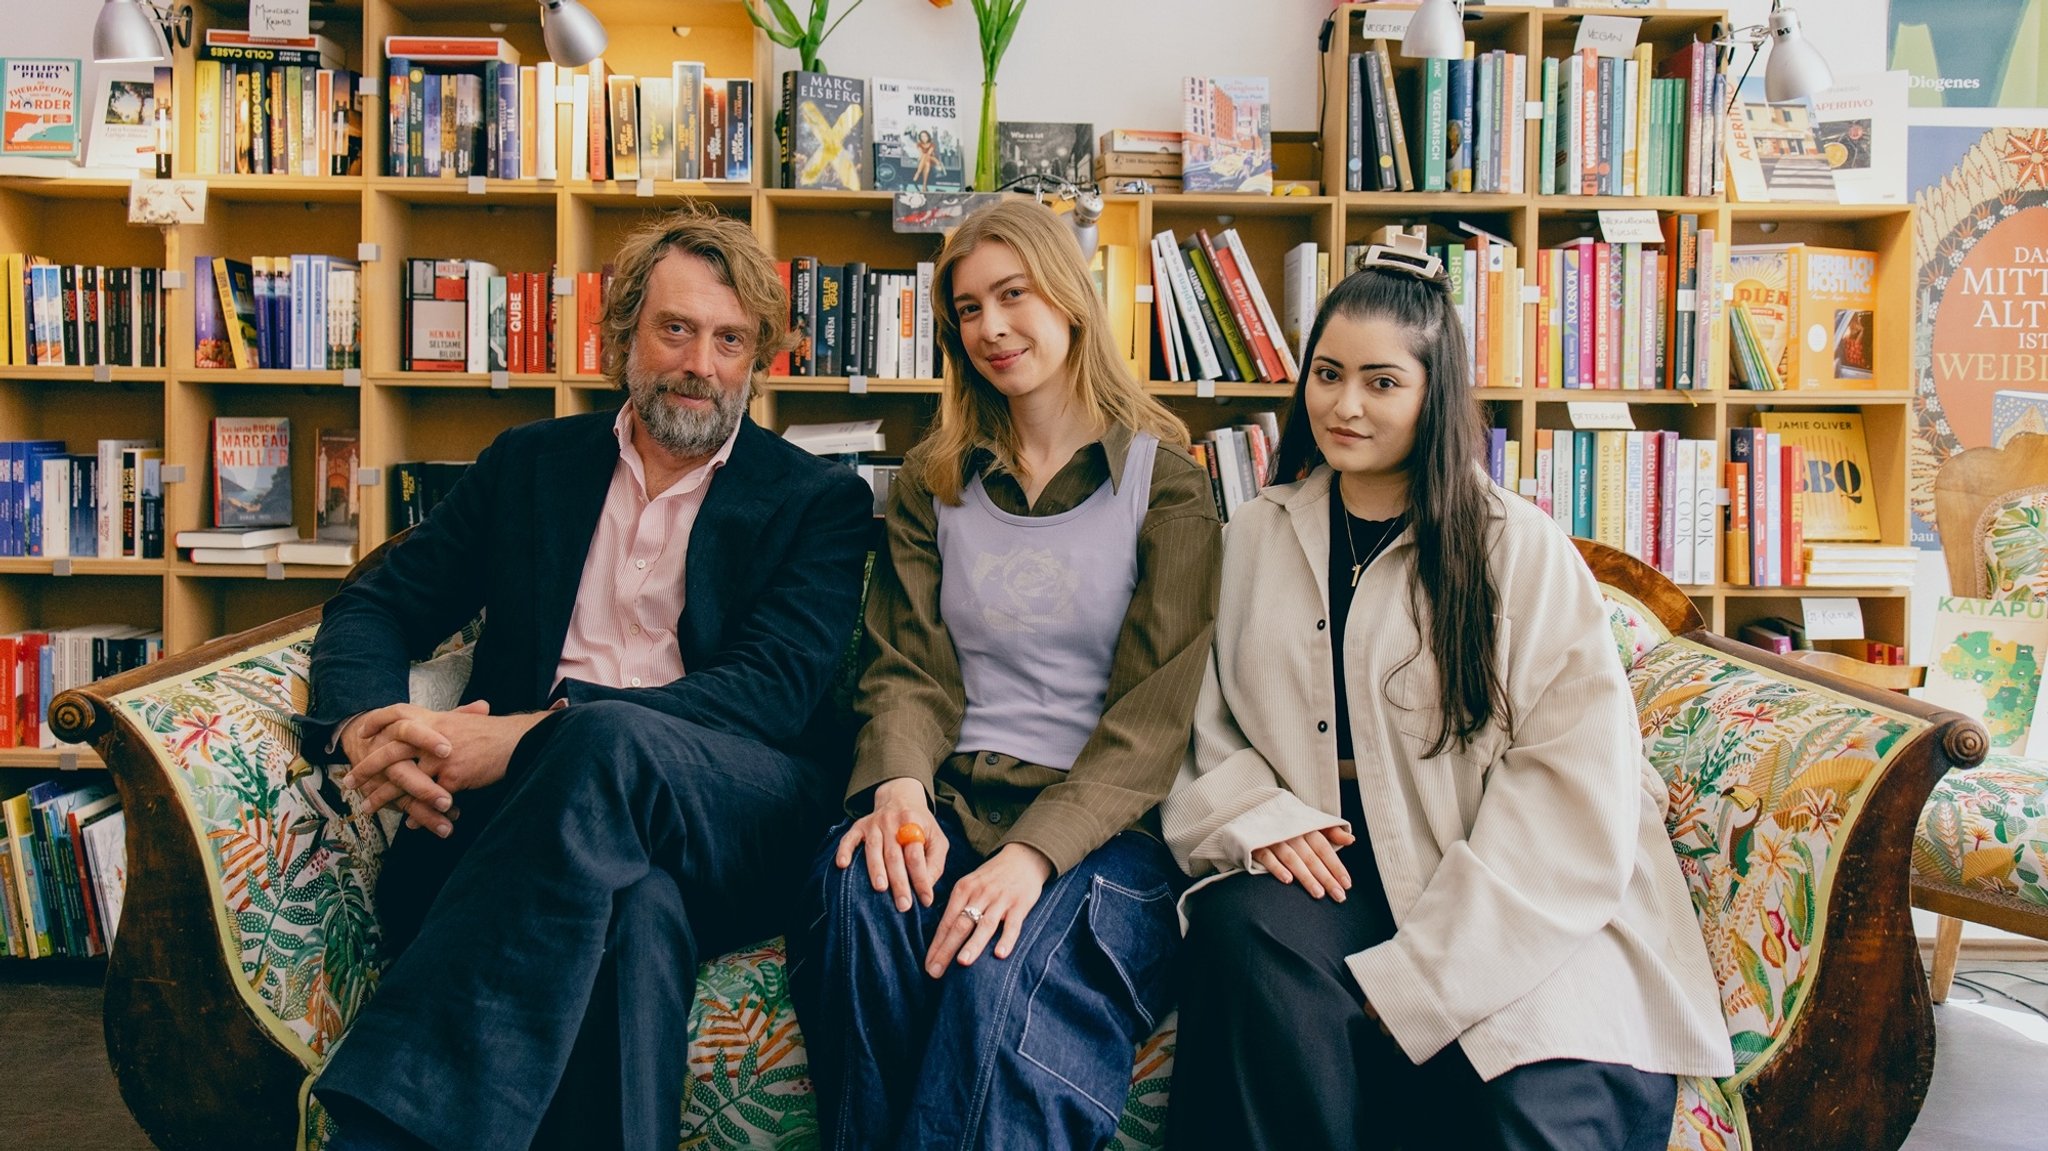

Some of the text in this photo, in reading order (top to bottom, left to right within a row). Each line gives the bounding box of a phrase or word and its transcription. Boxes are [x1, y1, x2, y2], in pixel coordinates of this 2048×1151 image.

[1587, 29, 1623, 42] VEGAN
[211, 47, 242, 57] CASES
[244, 50, 274, 60] COLD
[12, 64, 70, 72] PHILIPPA
[8, 84, 73, 98] THERAPEUTIN
[800, 86, 861, 103] ELSBERG
[810, 75, 853, 91] MARC
[879, 83, 899, 92] KRIMI
[1908, 75, 1981, 92] Diogenes
[251, 71, 262, 134] COLD CASES
[908, 105, 956, 119] PROZESS
[914, 93, 956, 106] KURZER
[1813, 98, 1874, 111] APERITIVO
[1010, 131, 1023, 139] Wie
[1431, 89, 1442, 160] VEGETARISCH
[1464, 107, 1472, 144] LOW CARB
[1680, 220, 1689, 285] JAPANISCHEN
[2015, 247, 2048, 264] DAS
[437, 264, 464, 273] UKETSU
[921, 272, 929, 290] WOLF
[1451, 256, 1462, 295] NOSH
[1960, 267, 2048, 296] MITT
[62, 289, 71, 322] ACHTSAM
[69, 290, 77, 321] MORDEN
[89, 290, 97, 321] MORDEN
[822, 276, 832, 311] WELLEN
[830, 281, 839, 307] GRAB
[1176, 272, 1196, 313] Sapiens
[1566, 270, 1579, 324] MONSOON
[83, 289, 91, 323] ACHTSAM
[510, 292, 522, 333] QUBE
[1598, 262, 1608, 372] KOREANISCHE KÜCHE
[1974, 300, 2046, 328] ALT
[1221, 316, 1232, 332] und
[1644, 307, 1653, 352] AYURVEDA
[1656, 271, 1665, 368] 30 PFLANZEN WOCHE
[429, 331, 462, 339] HEN NA E
[429, 340, 462, 349] SELTSAME
[1226, 330, 1243, 355] Ingrid
[2018, 333, 2048, 349] IST
[439, 350, 462, 359] BILDER
[252, 424, 275, 432] BUCH
[1777, 420, 1853, 431] JAMIE OLIVER
[222, 434, 288, 448] MARCEAU
[222, 450, 288, 466] MILLER
[1628, 440, 1642, 489] JERUSALEM
[1540, 454, 1549, 498] Ottolenghi
[1601, 445, 1609, 512] OTTOLENGHI
[1613, 445, 1621, 512] OTTOLENGHI
[1578, 468, 1588, 518] Das Kochbuch
[1645, 443, 1655, 557] OTTOLENGHI FLAVOUR
[1755, 474, 1766, 509] OSTSEE
[1676, 487, 1692, 545] COOK
[1697, 488, 1714, 547] COOK
[1664, 510, 1674, 549] vegetarisch
[1910, 529, 1935, 543] bau
[1937, 596, 2046, 620] KATAPU
